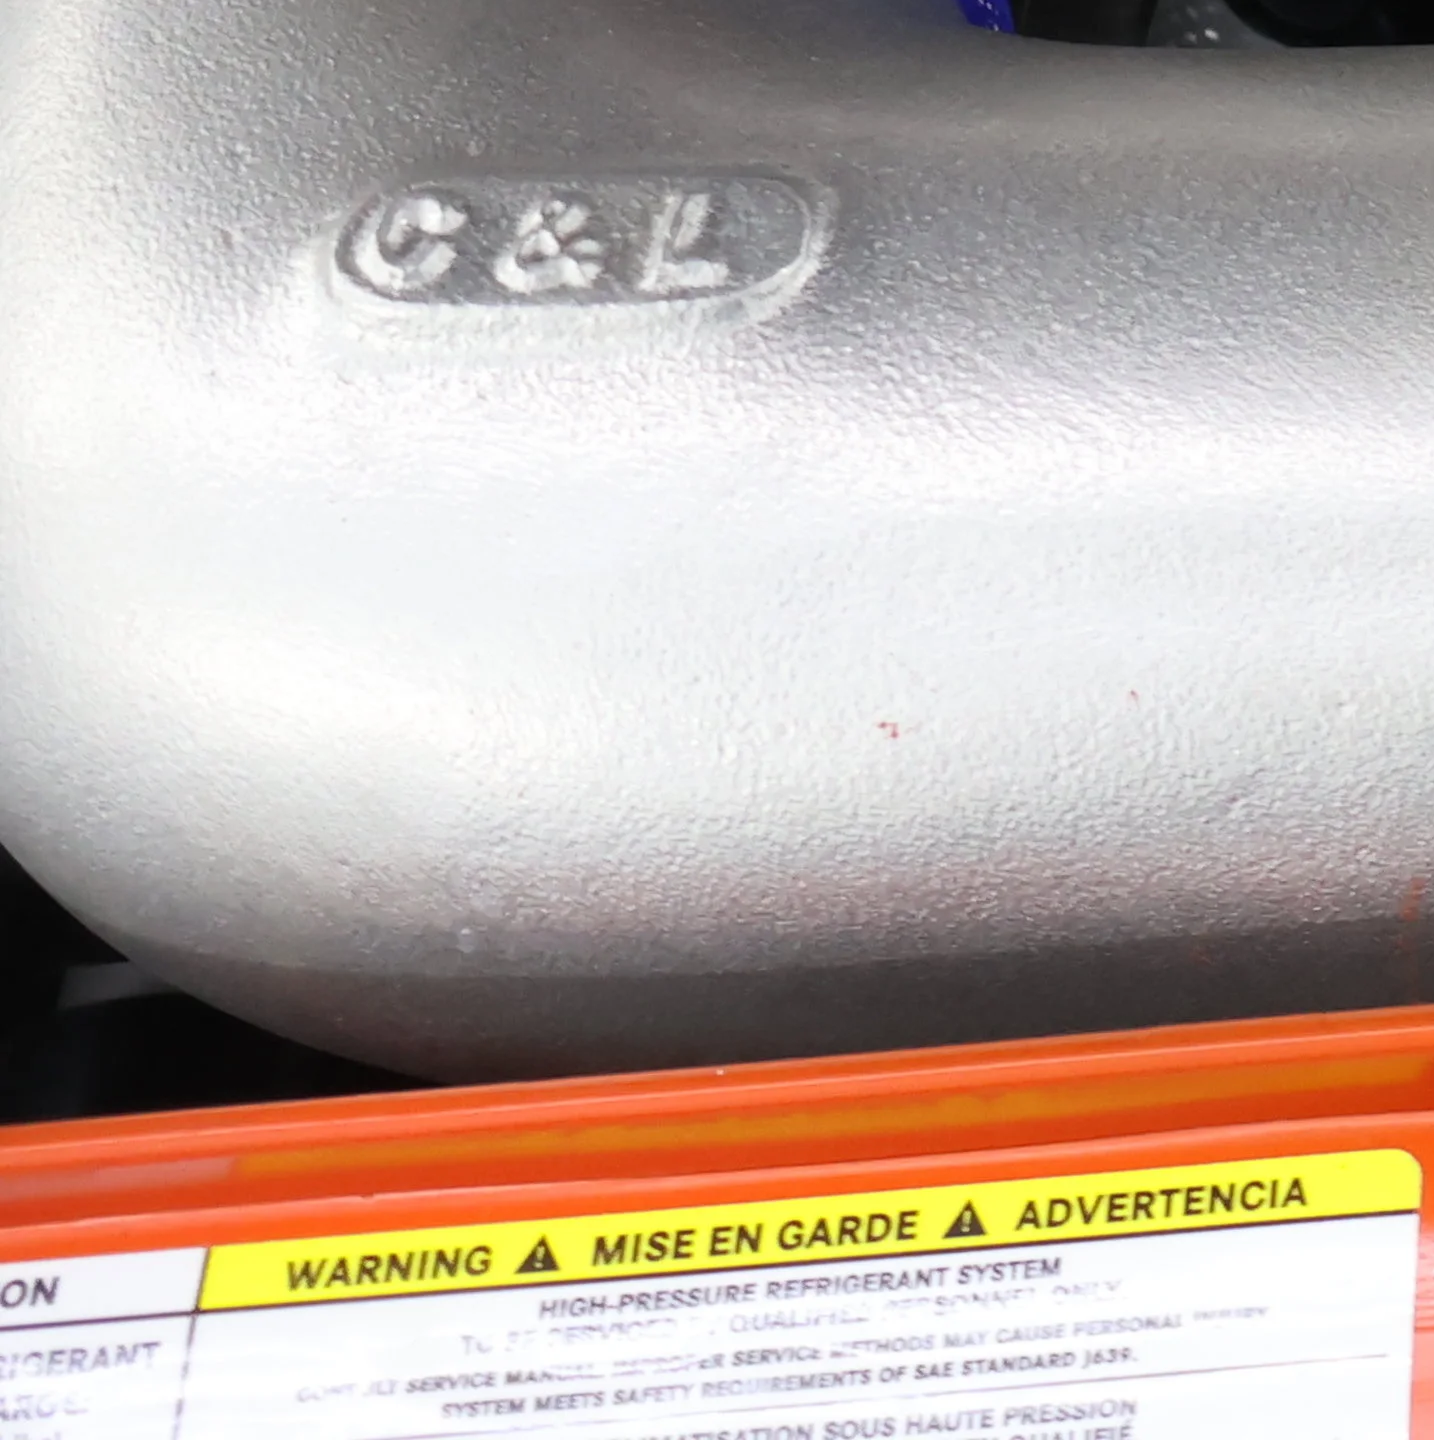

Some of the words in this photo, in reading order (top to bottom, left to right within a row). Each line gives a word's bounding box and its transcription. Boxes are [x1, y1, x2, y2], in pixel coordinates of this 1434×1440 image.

[286, 1245, 494, 1292] WARNING
[592, 1226, 695, 1268] MISE
[708, 1223, 761, 1258] EN
[777, 1210, 919, 1251] GARDE
[1014, 1176, 1308, 1231] ADVERTENCIA
[538, 1282, 758, 1321] HIGH-PRESSURE
[765, 1267, 950, 1302] REFRIGERANT
[957, 1256, 1062, 1286] SYSTEM
[731, 1345, 822, 1369] SERVICE
[943, 1330, 988, 1350] MAY
[995, 1323, 1066, 1345] CAUSE
[405, 1370, 498, 1395] SERVICE
[441, 1397, 526, 1420] SYSTEM
[533, 1389, 606, 1413] MEETS
[612, 1383, 695, 1406] SAFETY
[878, 1365, 908, 1384] OF
[914, 1361, 954, 1381] SAE
[961, 1351, 1077, 1376] STANDARD
[824, 1416, 898, 1440] SOUS
[904, 1407, 997, 1436] HAUTE
[1002, 1398, 1139, 1427] PRESSION
